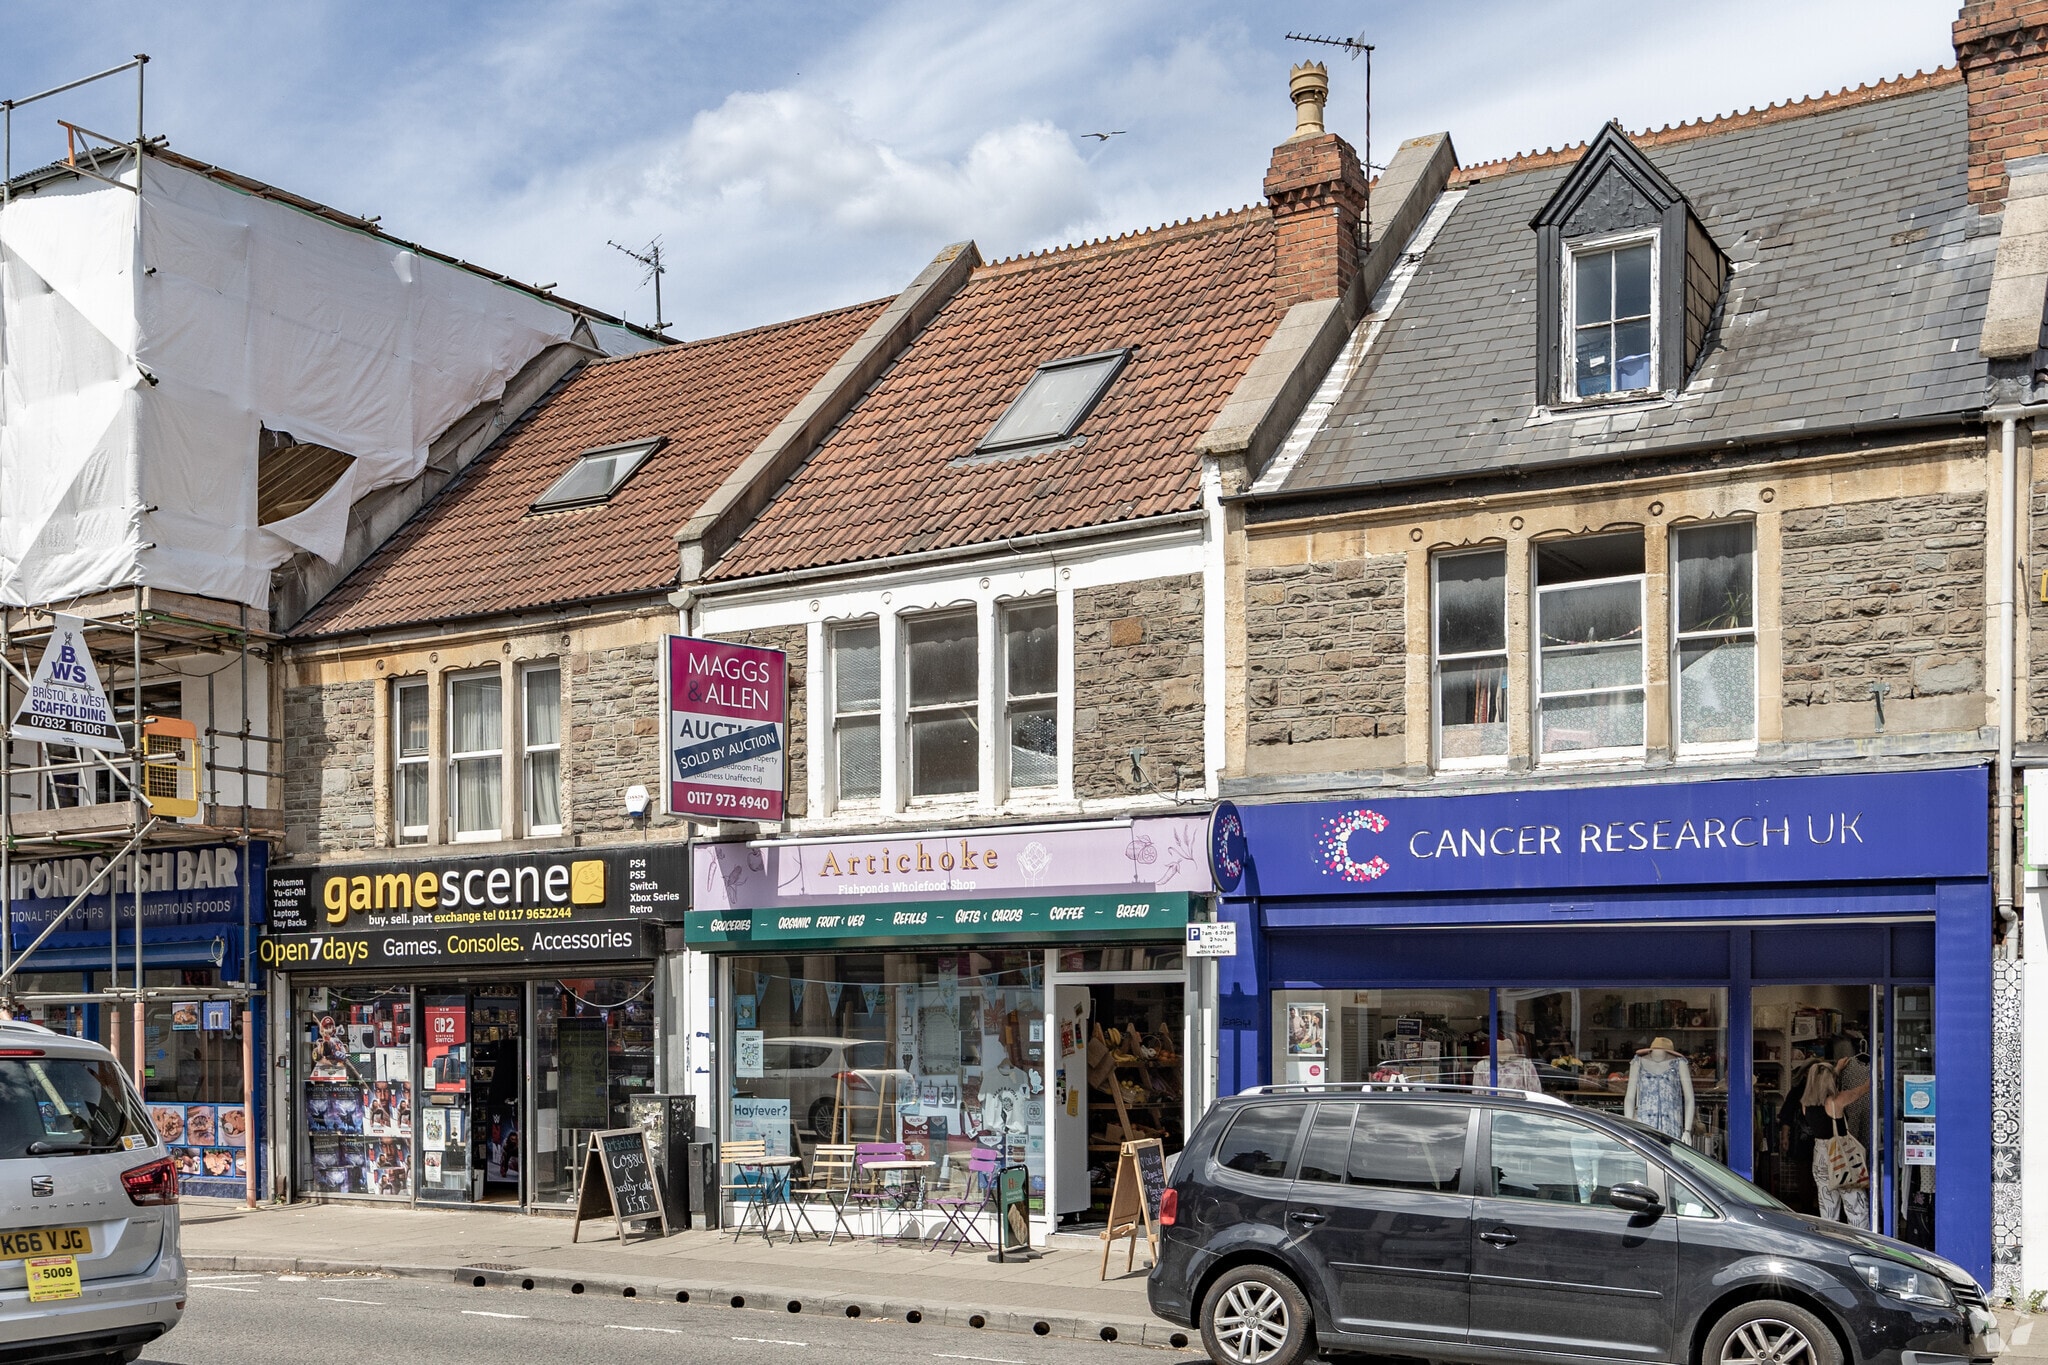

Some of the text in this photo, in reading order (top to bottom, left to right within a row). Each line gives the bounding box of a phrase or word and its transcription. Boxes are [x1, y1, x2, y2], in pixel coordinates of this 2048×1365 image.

[61, 645, 76, 663] B
[51, 661, 87, 683] WS
[688, 652, 770, 684] MAGGS
[32, 685, 69, 703] BRISTOL
[71, 692, 78, 704] &
[80, 694, 106, 708] WEST
[688, 680, 769, 711] & ALLEN
[32, 699, 106, 722] SCAFFOLDING
[30, 714, 107, 736] 07932 161061
[679, 731, 776, 770] SOLD BY AUCTION
[753, 764, 765, 773] Flat
[724, 773, 763, 785] Unaffected)
[687, 790, 769, 810] 0117 973 4940
[1408, 824, 1562, 859] CANCER
[1580, 815, 1790, 855] RESEARCH
[1807, 811, 1864, 846] UK
[629, 859, 646, 868] PS4
[818, 838, 999, 877] Artichoke
[177, 847, 239, 890] BAR
[629, 871, 646, 880] PS5
[273, 879, 304, 887] Pokemon
[629, 881, 658, 891] Switch
[838, 879, 976, 896] Fishponds Wholefood Shop
[273, 887, 306, 898] Yu-Gi-Oh!
[324, 864, 569, 923] gamescene
[630, 891, 680, 903] Xbox Series
[123, 900, 231, 917] SCUMPTIOUS FOODS
[273, 898, 298, 908] Tablets
[629, 905, 653, 914] Retro
[11, 911, 43, 923] TIONAL
[76, 906, 104, 920] CHIPS
[273, 909, 300, 919] Laptops
[368, 907, 572, 927] buy. sell. part exchange tel 0117 9652244
[710, 918, 752, 932] GROCERIES
[778, 916, 811, 930] ORGANIC
[815, 915, 840, 928] FRUIT
[847, 914, 866, 927] VEG
[892, 911, 928, 925] REFILLS
[955, 909, 981, 923] GIFTS
[991, 908, 1023, 923] CARDS
[1049, 906, 1086, 921] COFFEE
[1115, 904, 1150, 919] BREAD
[273, 918, 307, 929] Buy Backs
[383, 928, 632, 957] Games. Consoles. Accessories
[1190, 929, 1199, 940] P
[260, 936, 369, 967] Open7days
[734, 1104, 788, 1118] Hayfever?
[46, 1229, 83, 1250] VJG
[43, 1266, 73, 1279] 5009
